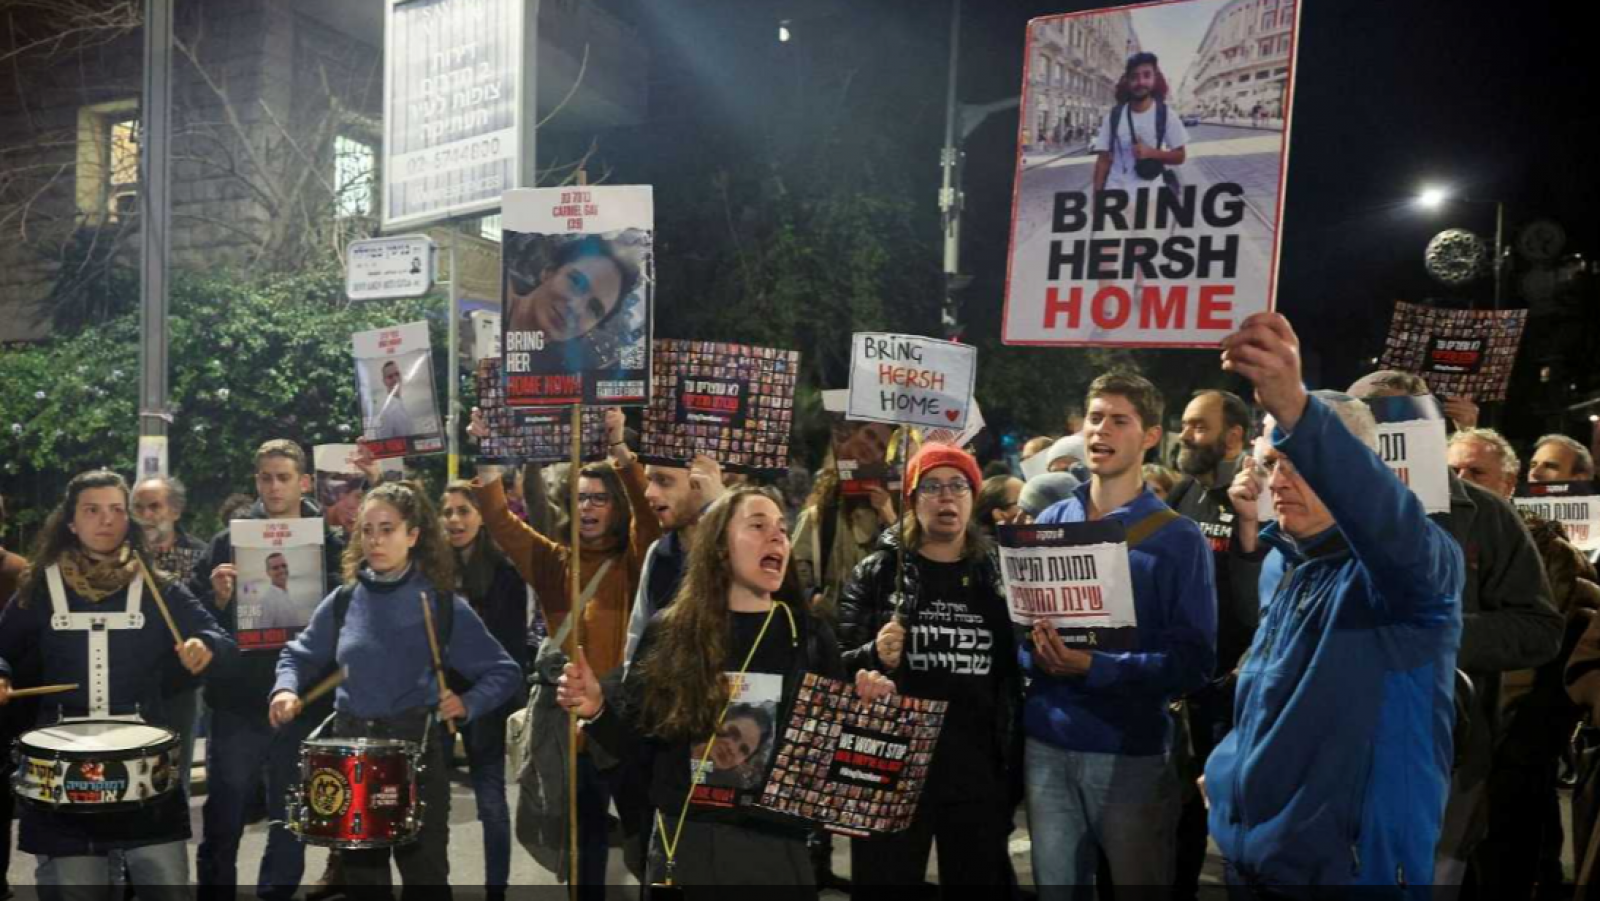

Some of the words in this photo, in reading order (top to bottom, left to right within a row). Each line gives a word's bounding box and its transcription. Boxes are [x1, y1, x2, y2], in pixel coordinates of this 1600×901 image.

[453, 82, 501, 108] צופות
[1052, 182, 1245, 233] BRING
[1047, 234, 1240, 280] HERSH
[1043, 285, 1235, 330] HOME
[506, 331, 545, 351] BRING
[506, 352, 531, 372] HER
[506, 376, 542, 397] HOME
[879, 364, 945, 390] HERSH
[880, 390, 940, 415] HOME
[1200, 522, 1232, 538] THEM
[1047, 554, 1097, 582] תמונת
[1061, 585, 1103, 611] שיבת
[910, 624, 993, 654] כפדיון
[906, 651, 992, 675] שבויים
[839, 733, 855, 750] WE
[856, 735, 886, 756] WON'T
[886, 743, 908, 759] STOP
